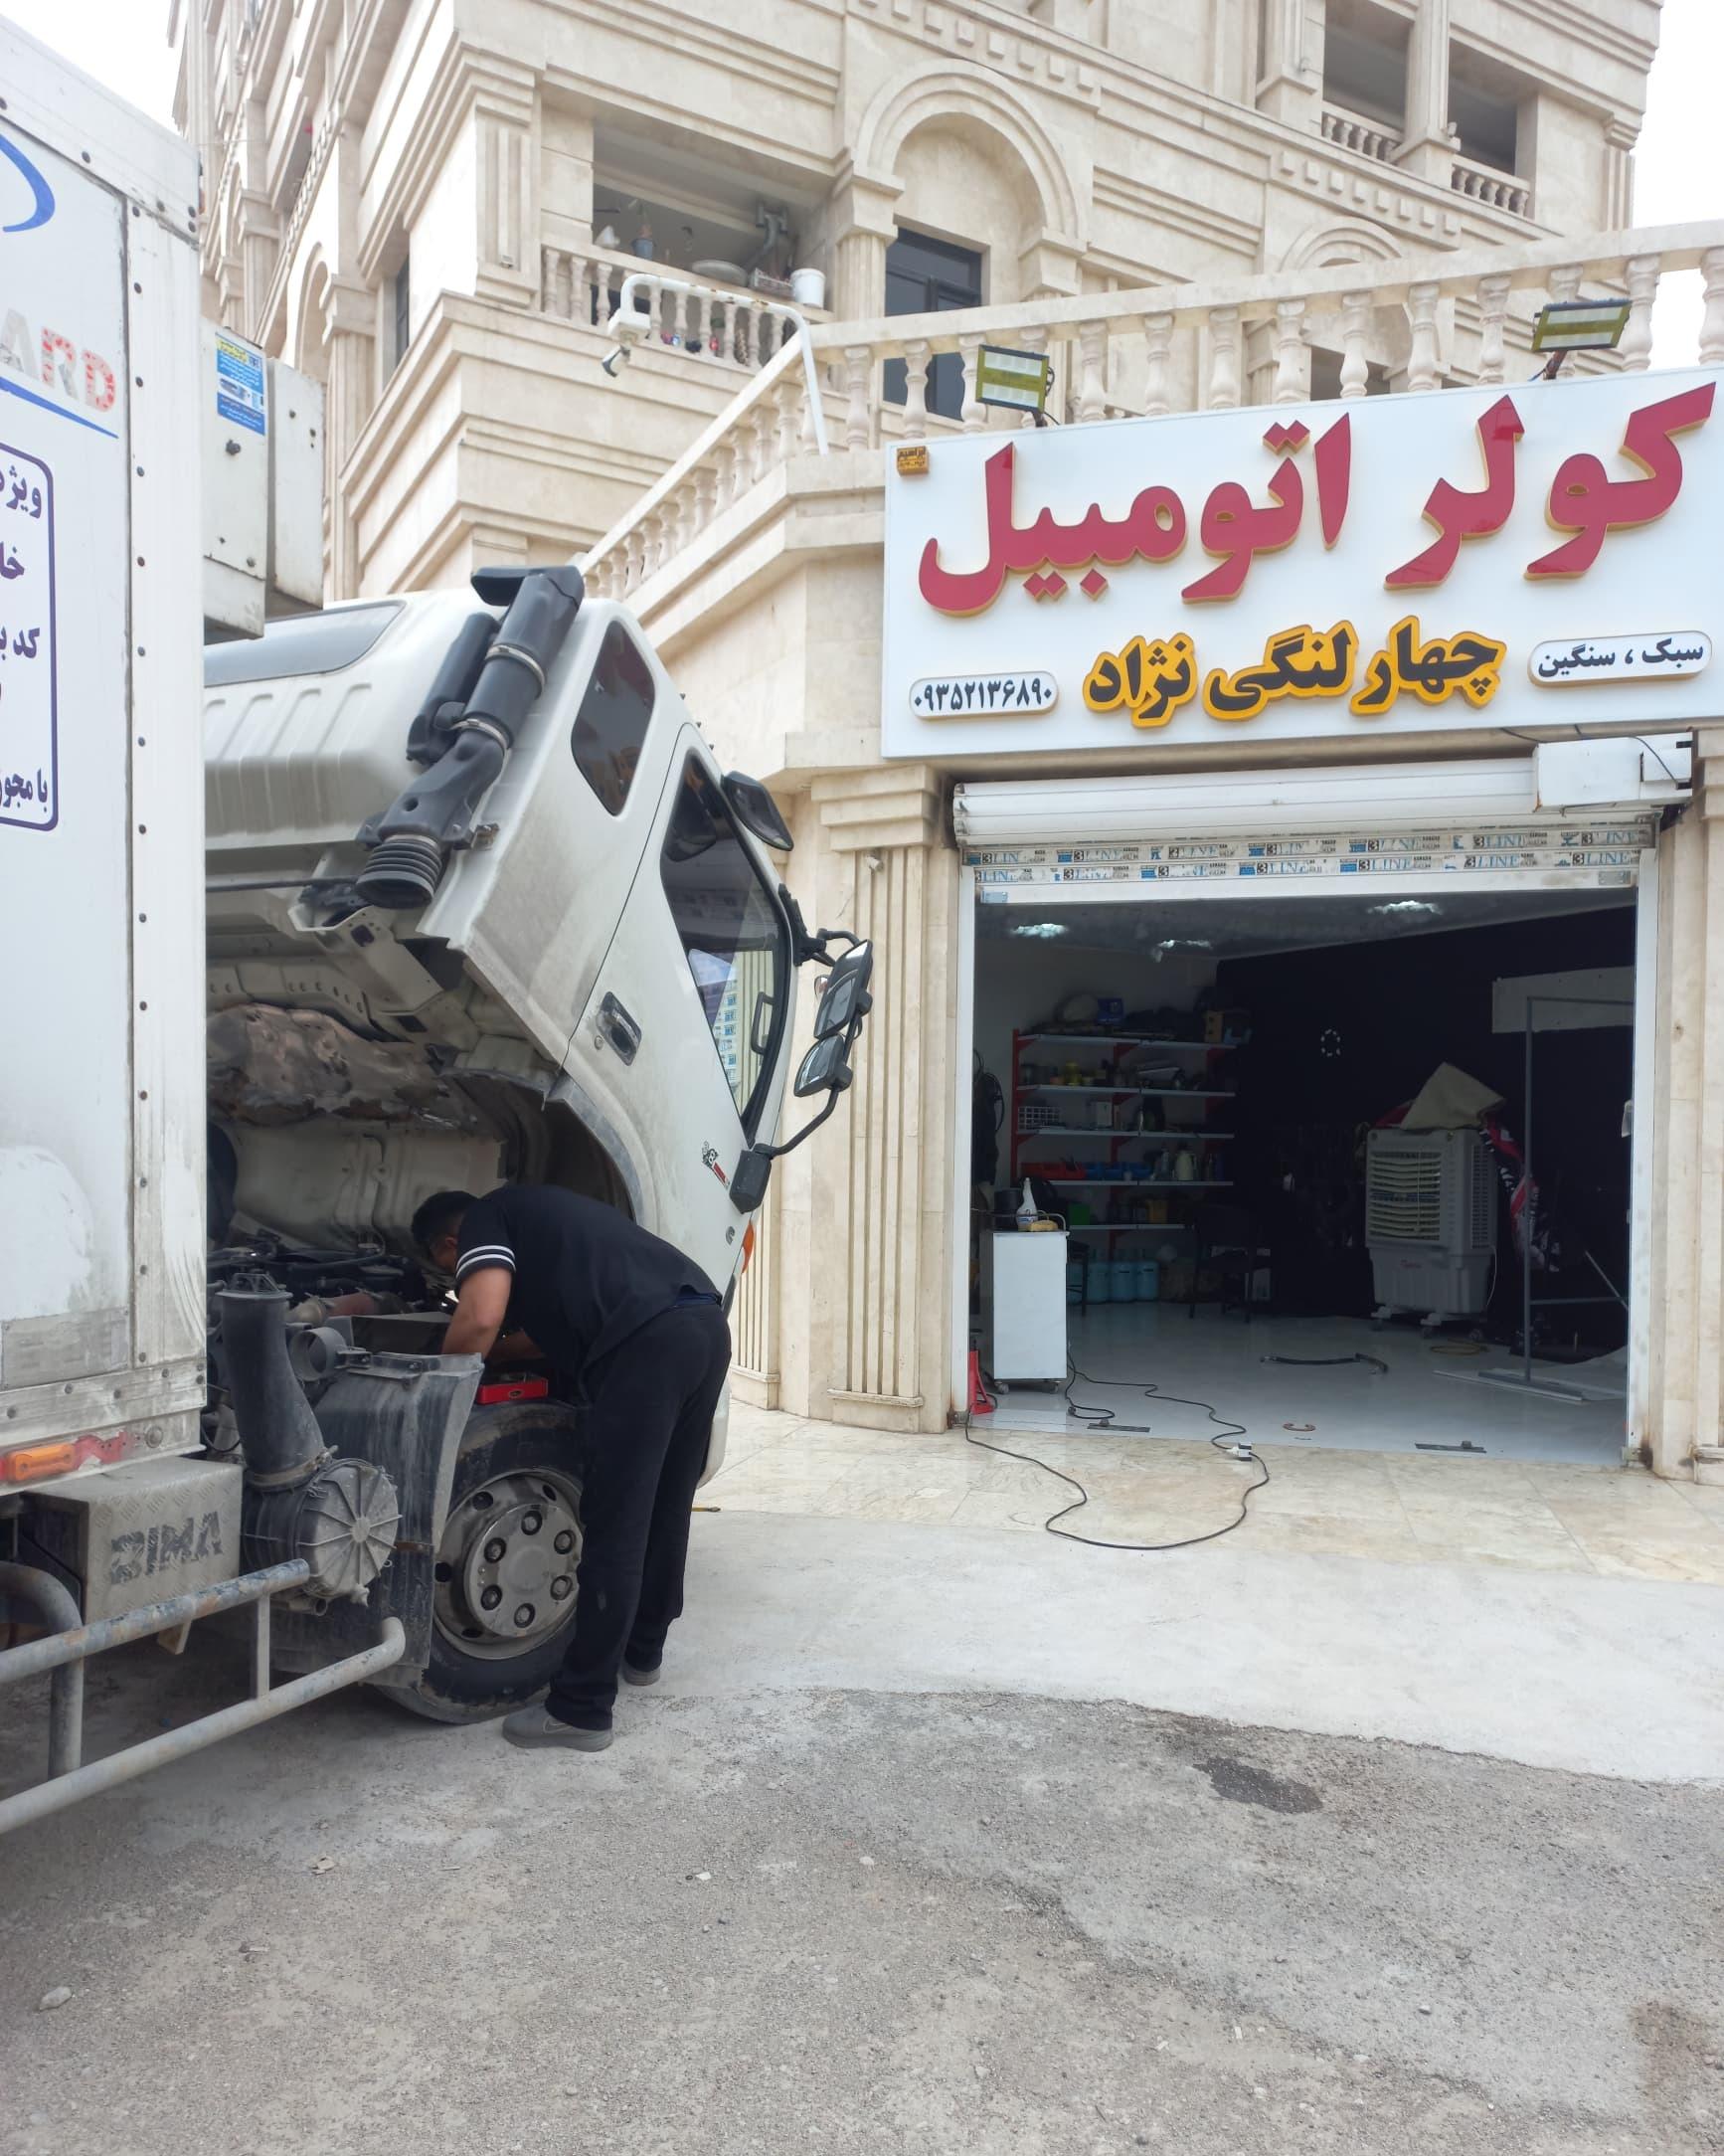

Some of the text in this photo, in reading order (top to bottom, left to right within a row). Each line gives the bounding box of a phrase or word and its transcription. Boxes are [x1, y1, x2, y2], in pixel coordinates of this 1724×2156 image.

[918, 382, 1716, 615] کولر اتومبیل
[1538, 643, 1616, 678] سنگین
[1641, 637, 1703, 668] سبک
[1088, 621, 1503, 721] چهار لنگی نژاد
[914, 677, 1052, 711] ۰۹۳۵۲۱۳۶۸۹۰
[0, 773, 33, 808] مجو
